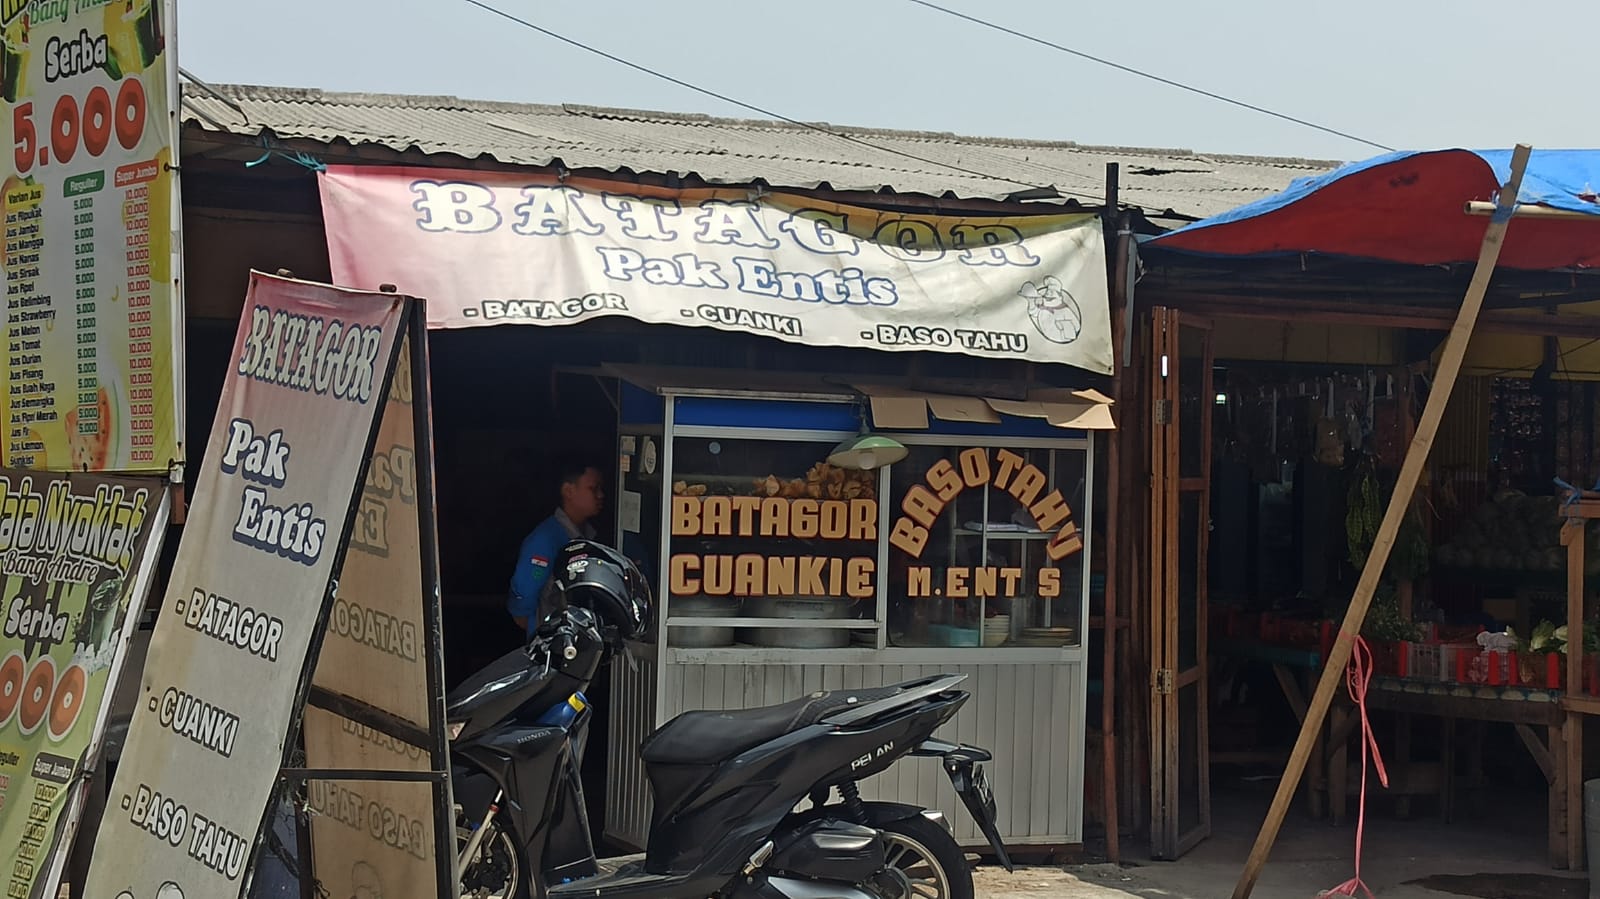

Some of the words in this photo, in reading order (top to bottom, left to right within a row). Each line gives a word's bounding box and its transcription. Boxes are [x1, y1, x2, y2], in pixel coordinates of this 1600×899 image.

[45, 28, 109, 82] Serba
[13, 77, 146, 174] 5.000
[30, 189, 41, 200] Jus
[6, 213, 16, 224] Jus
[74, 197, 93, 210] 5.000
[410, 179, 1041, 268] BATAGOR
[6, 227, 17, 238] Jus
[74, 213, 93, 225] 5.000
[6, 241, 17, 252] Jus
[19, 237, 44, 249] Mangga
[74, 228, 94, 240] 5.000
[6, 255, 18, 266] Jus
[75, 243, 94, 255] 5.000
[7, 269, 18, 280] Jus
[20, 267, 40, 278] Sirsak
[75, 258, 94, 270] 5.000
[596, 246, 728, 290] Pak
[734, 257, 898, 305] Entis
[7, 284, 18, 295] Jus
[75, 273, 94, 285] 5.000
[8, 298, 19, 308] Jus
[76, 288, 95, 300] 5.000
[481, 294, 628, 320] BATAGOR
[8, 312, 19, 323] Jus
[21, 309, 56, 321] Strawberry
[76, 303, 95, 315] 5.000
[696, 303, 802, 337] CUANKI
[9, 326, 20, 337] Jus
[76, 318, 96, 328] 5.000
[877, 324, 951, 348] BASO
[955, 329, 1028, 353] TAHU
[9, 341, 20, 352] Jus
[22, 340, 41, 350] Tomat
[77, 333, 96, 343] 5.000
[238, 304, 382, 404] BATAGOR
[9, 355, 20, 366] Jus
[77, 348, 96, 358] 5.000
[10, 369, 20, 380] Jus
[77, 362, 97, 373] 5.000
[10, 384, 21, 395] Jus
[78, 378, 97, 388] 5.000
[10, 398, 21, 409] Jus
[78, 393, 97, 403] 5.000
[11, 412, 21, 423] Jus
[78, 408, 97, 418] 5.000
[11, 426, 21, 437] Jus
[79, 423, 98, 433] 5.000
[10, 440, 20, 451] Jus
[220, 418, 290, 489] Pak
[38, 481, 148, 578] Nyoklat
[233, 486, 326, 566] Entis
[671, 495, 877, 541] BATAGOR
[4, 550, 48, 585] Bang
[48, 556, 100, 584] Andre
[669, 553, 876, 598] CUANKIE
[4, 596, 69, 643] Serba
[184, 586, 284, 663] BATAGOR
[159, 686, 240, 758] CUANKI
[516, 729, 552, 744] HONDA
[130, 783, 188, 848] BASO
[187, 815, 248, 879] TAHU
